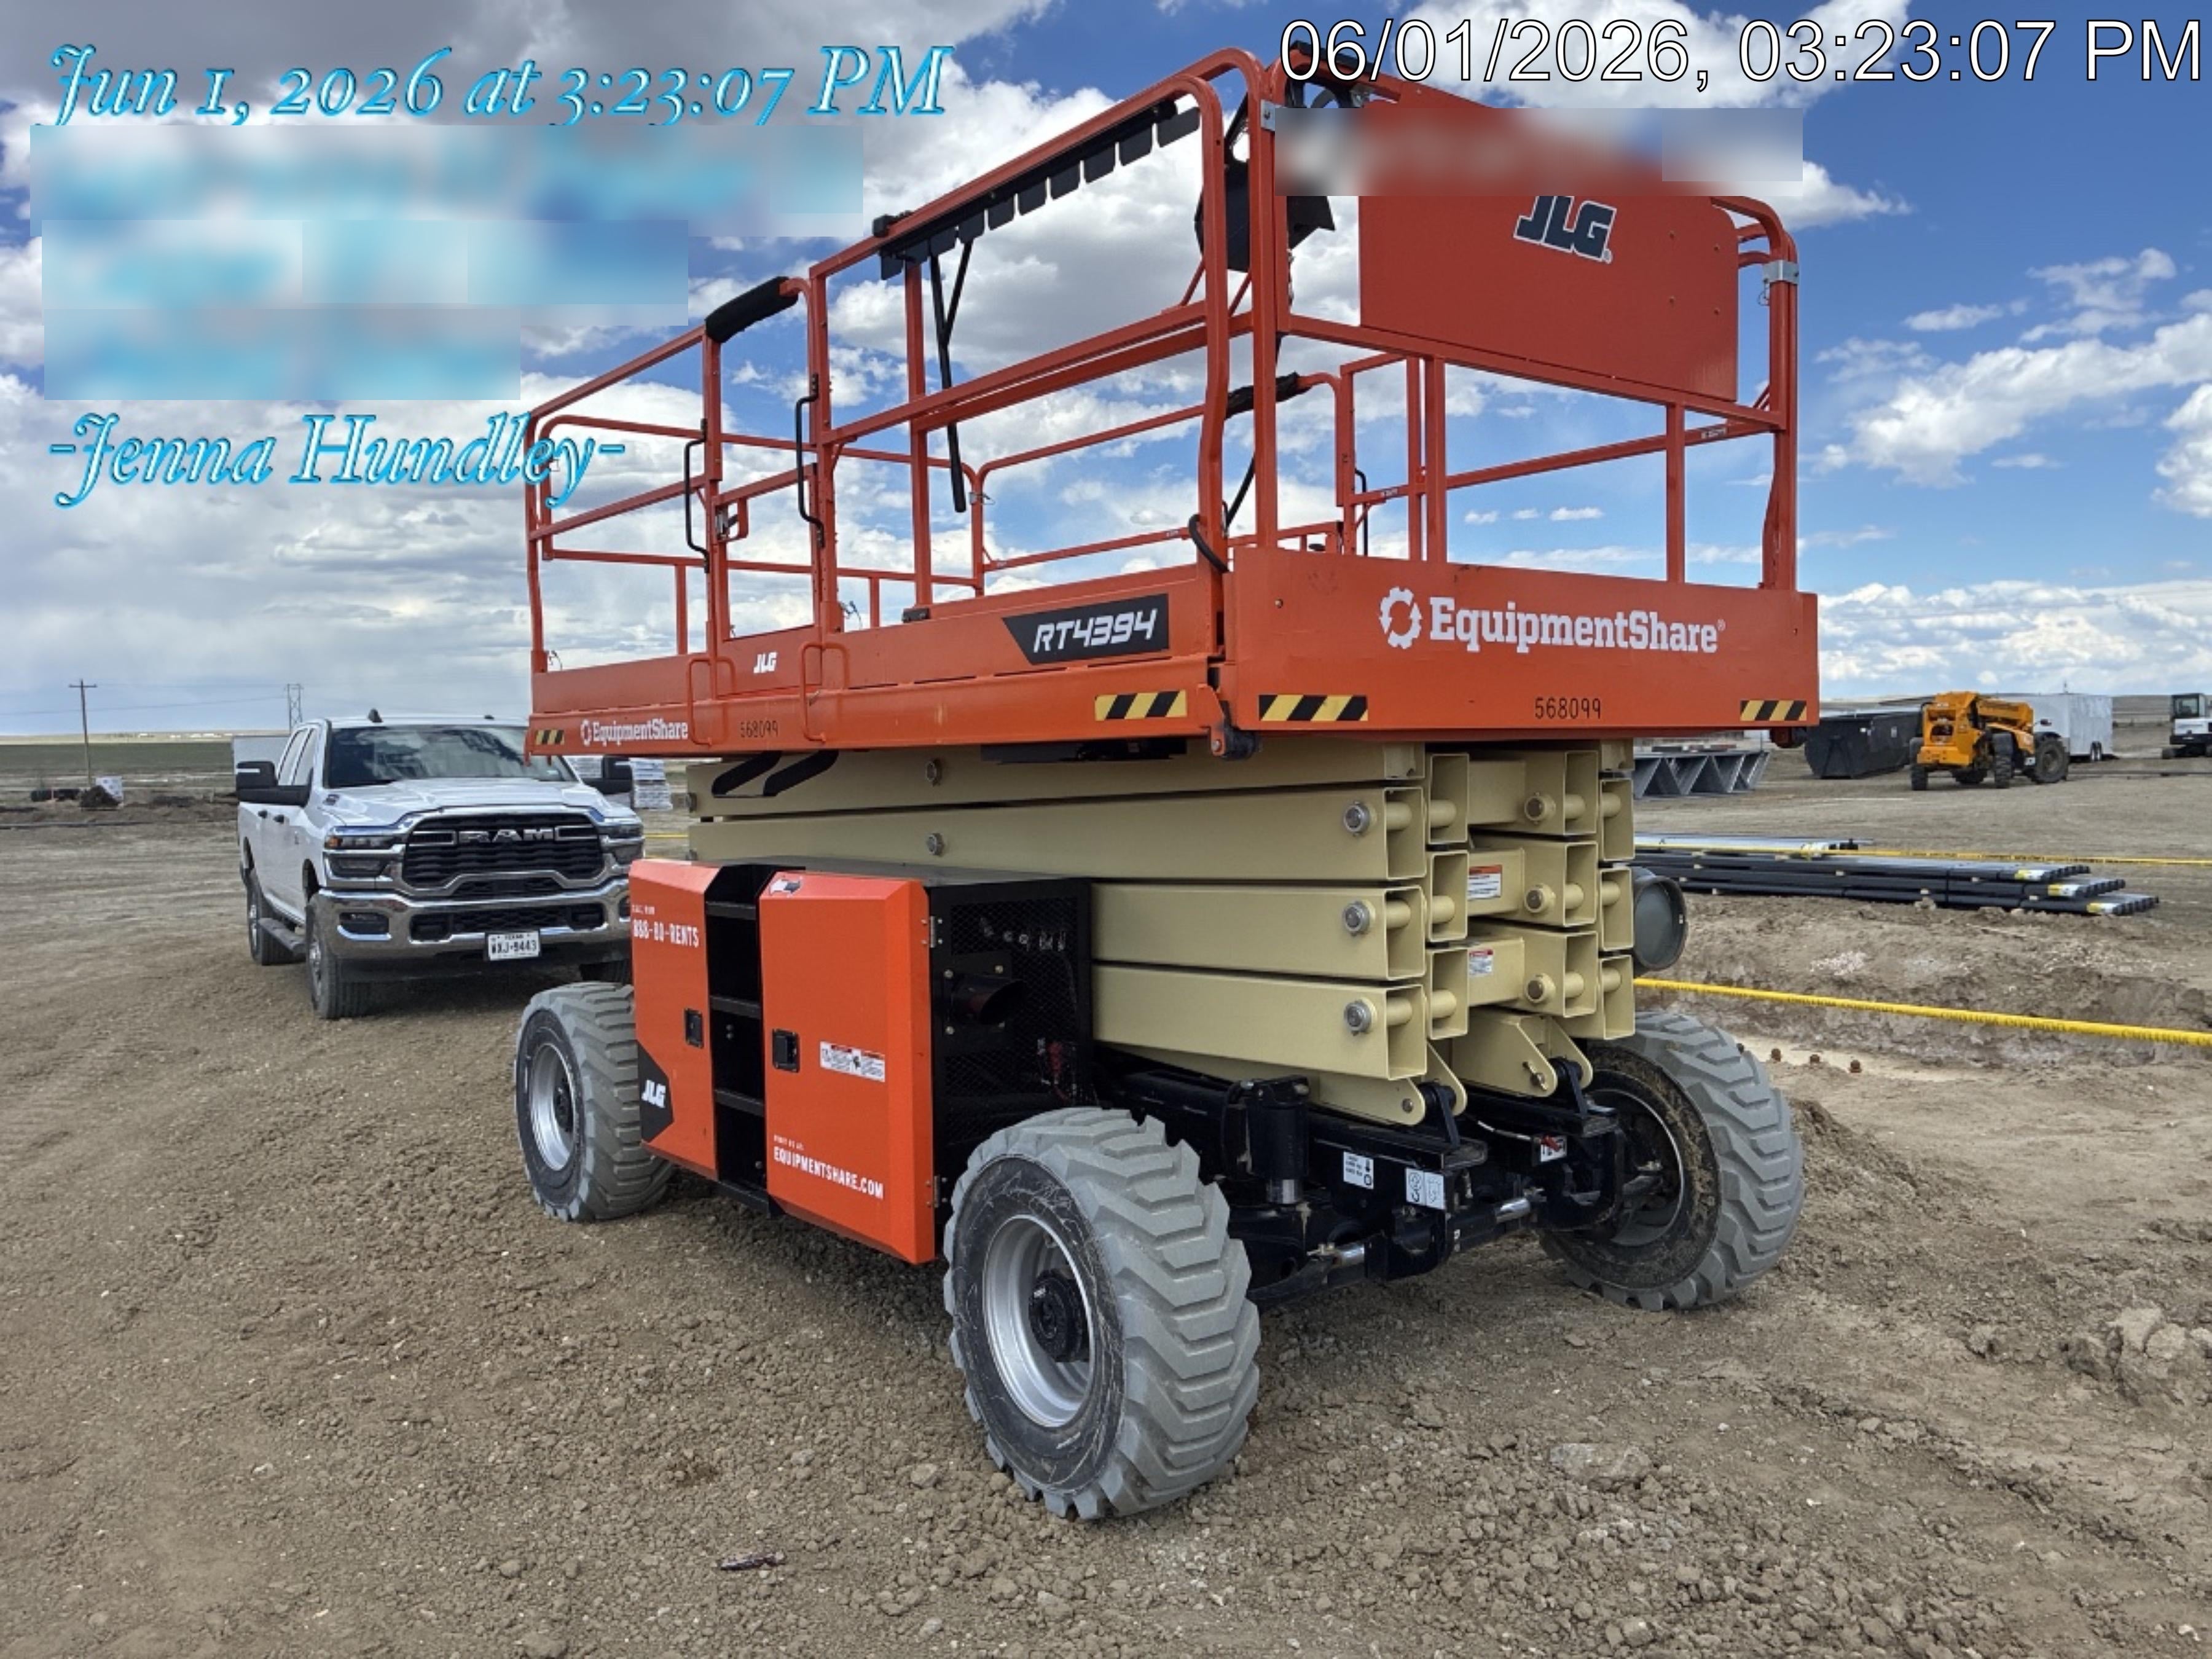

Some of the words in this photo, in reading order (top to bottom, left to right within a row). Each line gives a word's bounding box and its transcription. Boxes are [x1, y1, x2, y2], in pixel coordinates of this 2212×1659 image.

[1513, 195, 1617, 263] JLG
[1033, 608, 1158, 653] RT4394
[753, 651, 777, 674] JLG
[1534, 697, 1602, 720] 568099
[592, 718, 689, 747] EquipmentShare
[459, 828, 554, 844] RAM
[641, 1080, 666, 1108] JLG
[773, 1145, 884, 1200] EQUIPMENTSHARE.COM
